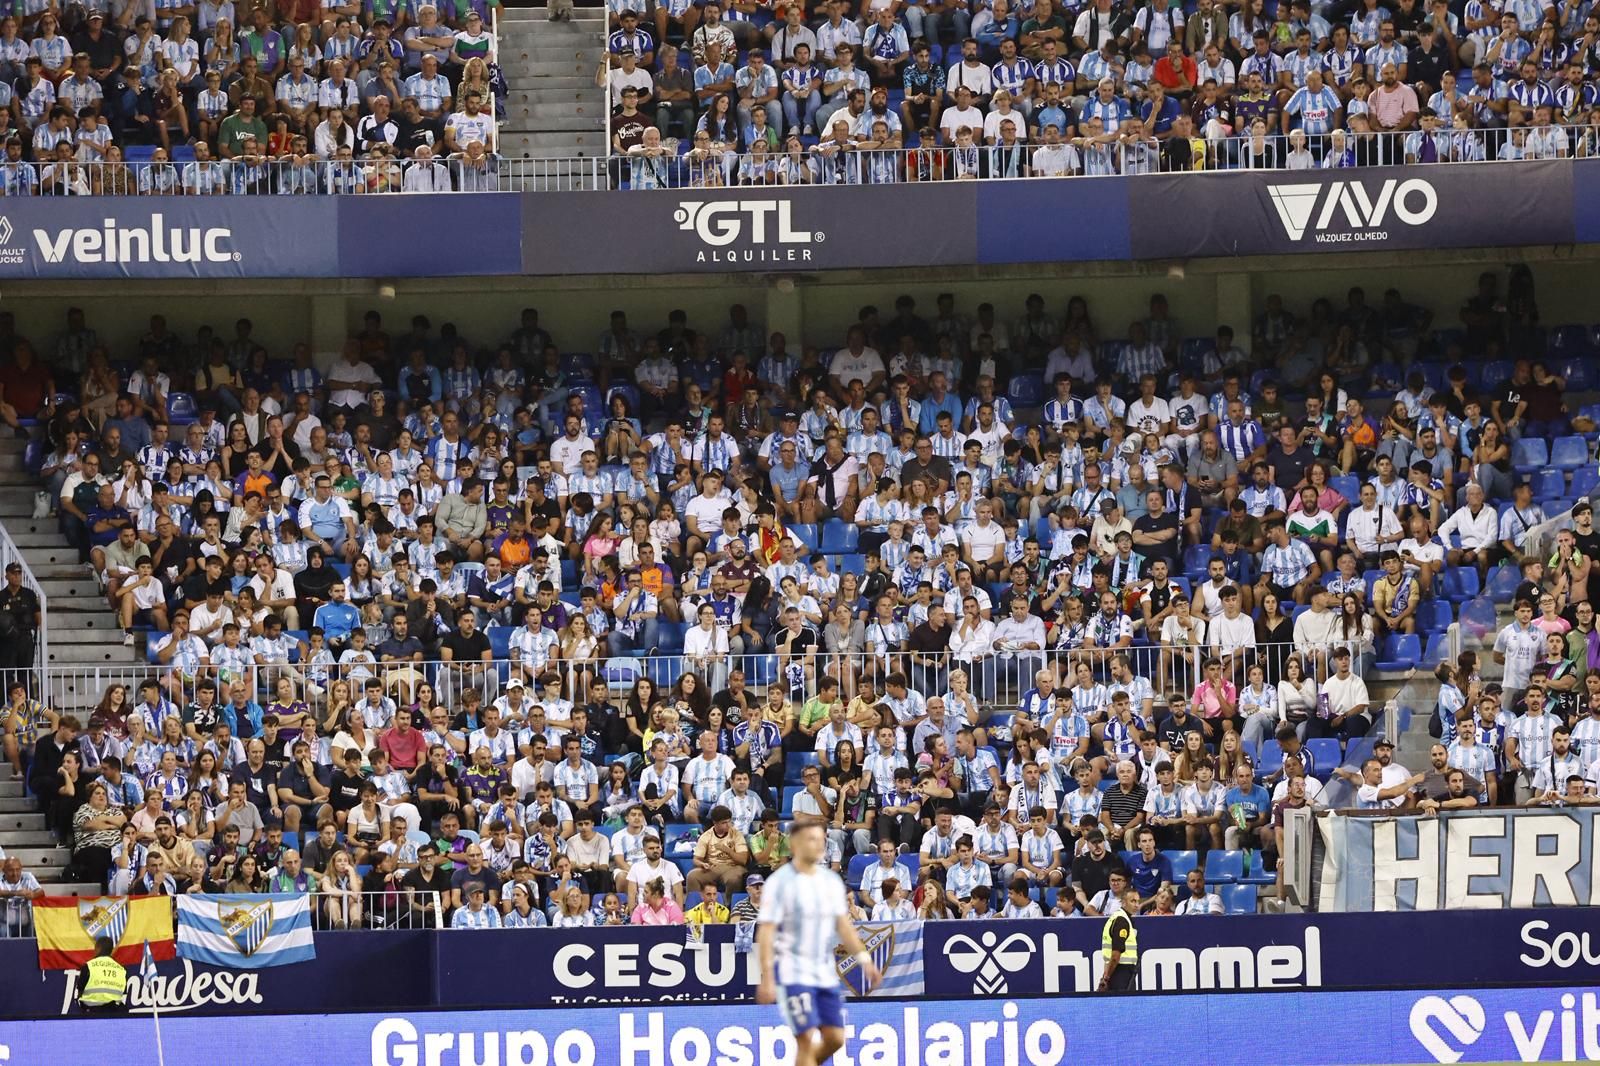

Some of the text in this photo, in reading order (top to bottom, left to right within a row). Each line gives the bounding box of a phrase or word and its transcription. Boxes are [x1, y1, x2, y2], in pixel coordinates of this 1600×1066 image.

[33, 213, 231, 262] veinluc
[696, 200, 811, 246] GTL
[1315, 231, 1388, 243] VÁZQUEZ OLMEDO
[0, 248, 26, 256] AULT
[697, 249, 812, 262] ALQUILER
[102, 969, 117, 978] 178
[1043, 926, 1321, 992] hmmel
[371, 1002, 1065, 1066] Grupo Hosptalario
